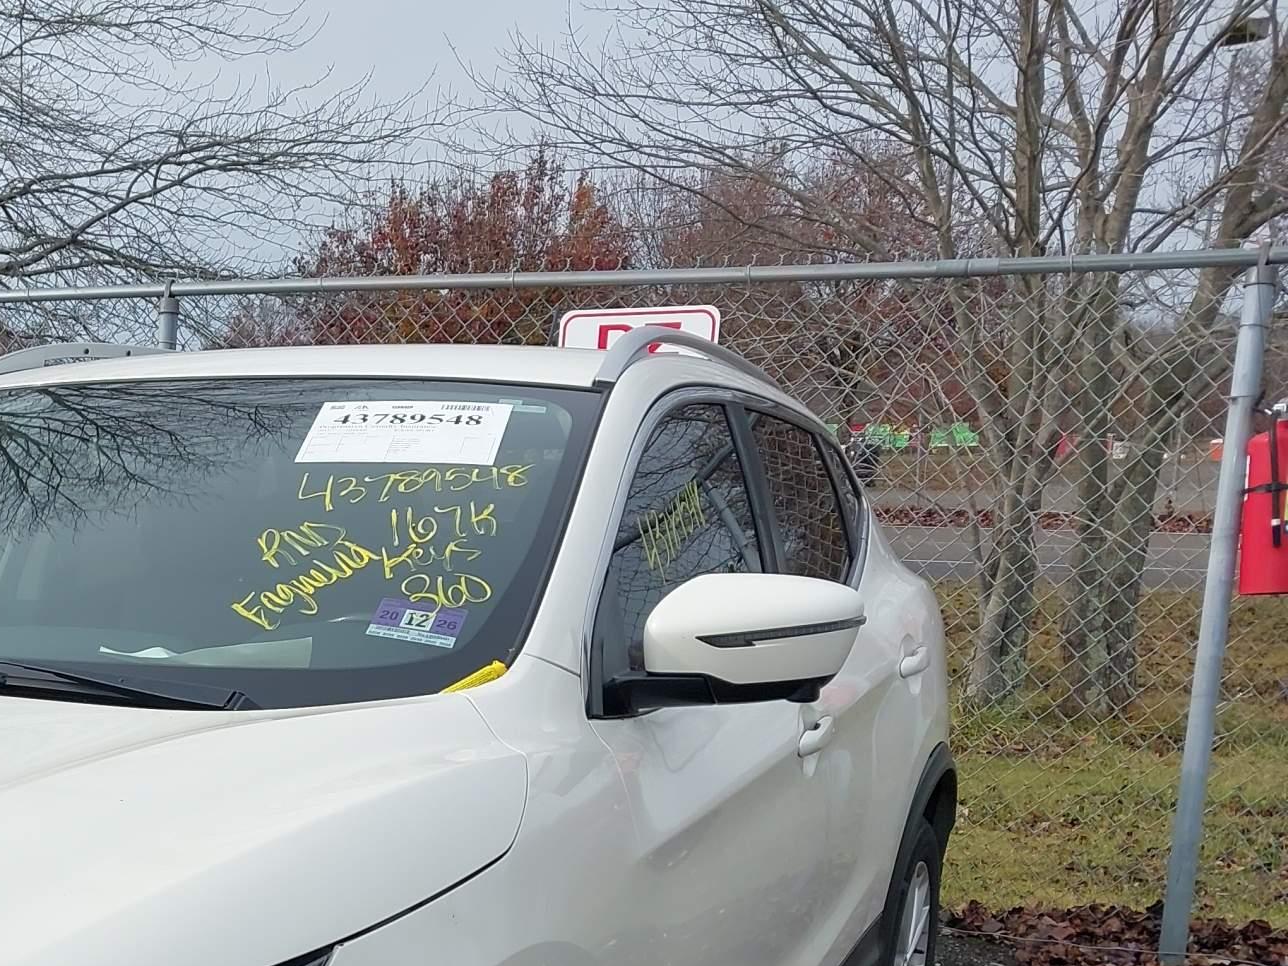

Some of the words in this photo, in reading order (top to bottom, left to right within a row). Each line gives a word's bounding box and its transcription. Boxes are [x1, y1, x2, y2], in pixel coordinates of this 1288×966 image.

[333, 413, 483, 425] 43789548
[379, 609, 399, 621] 20
[404, 612, 431, 628] 12
[436, 619, 458, 631] 26
